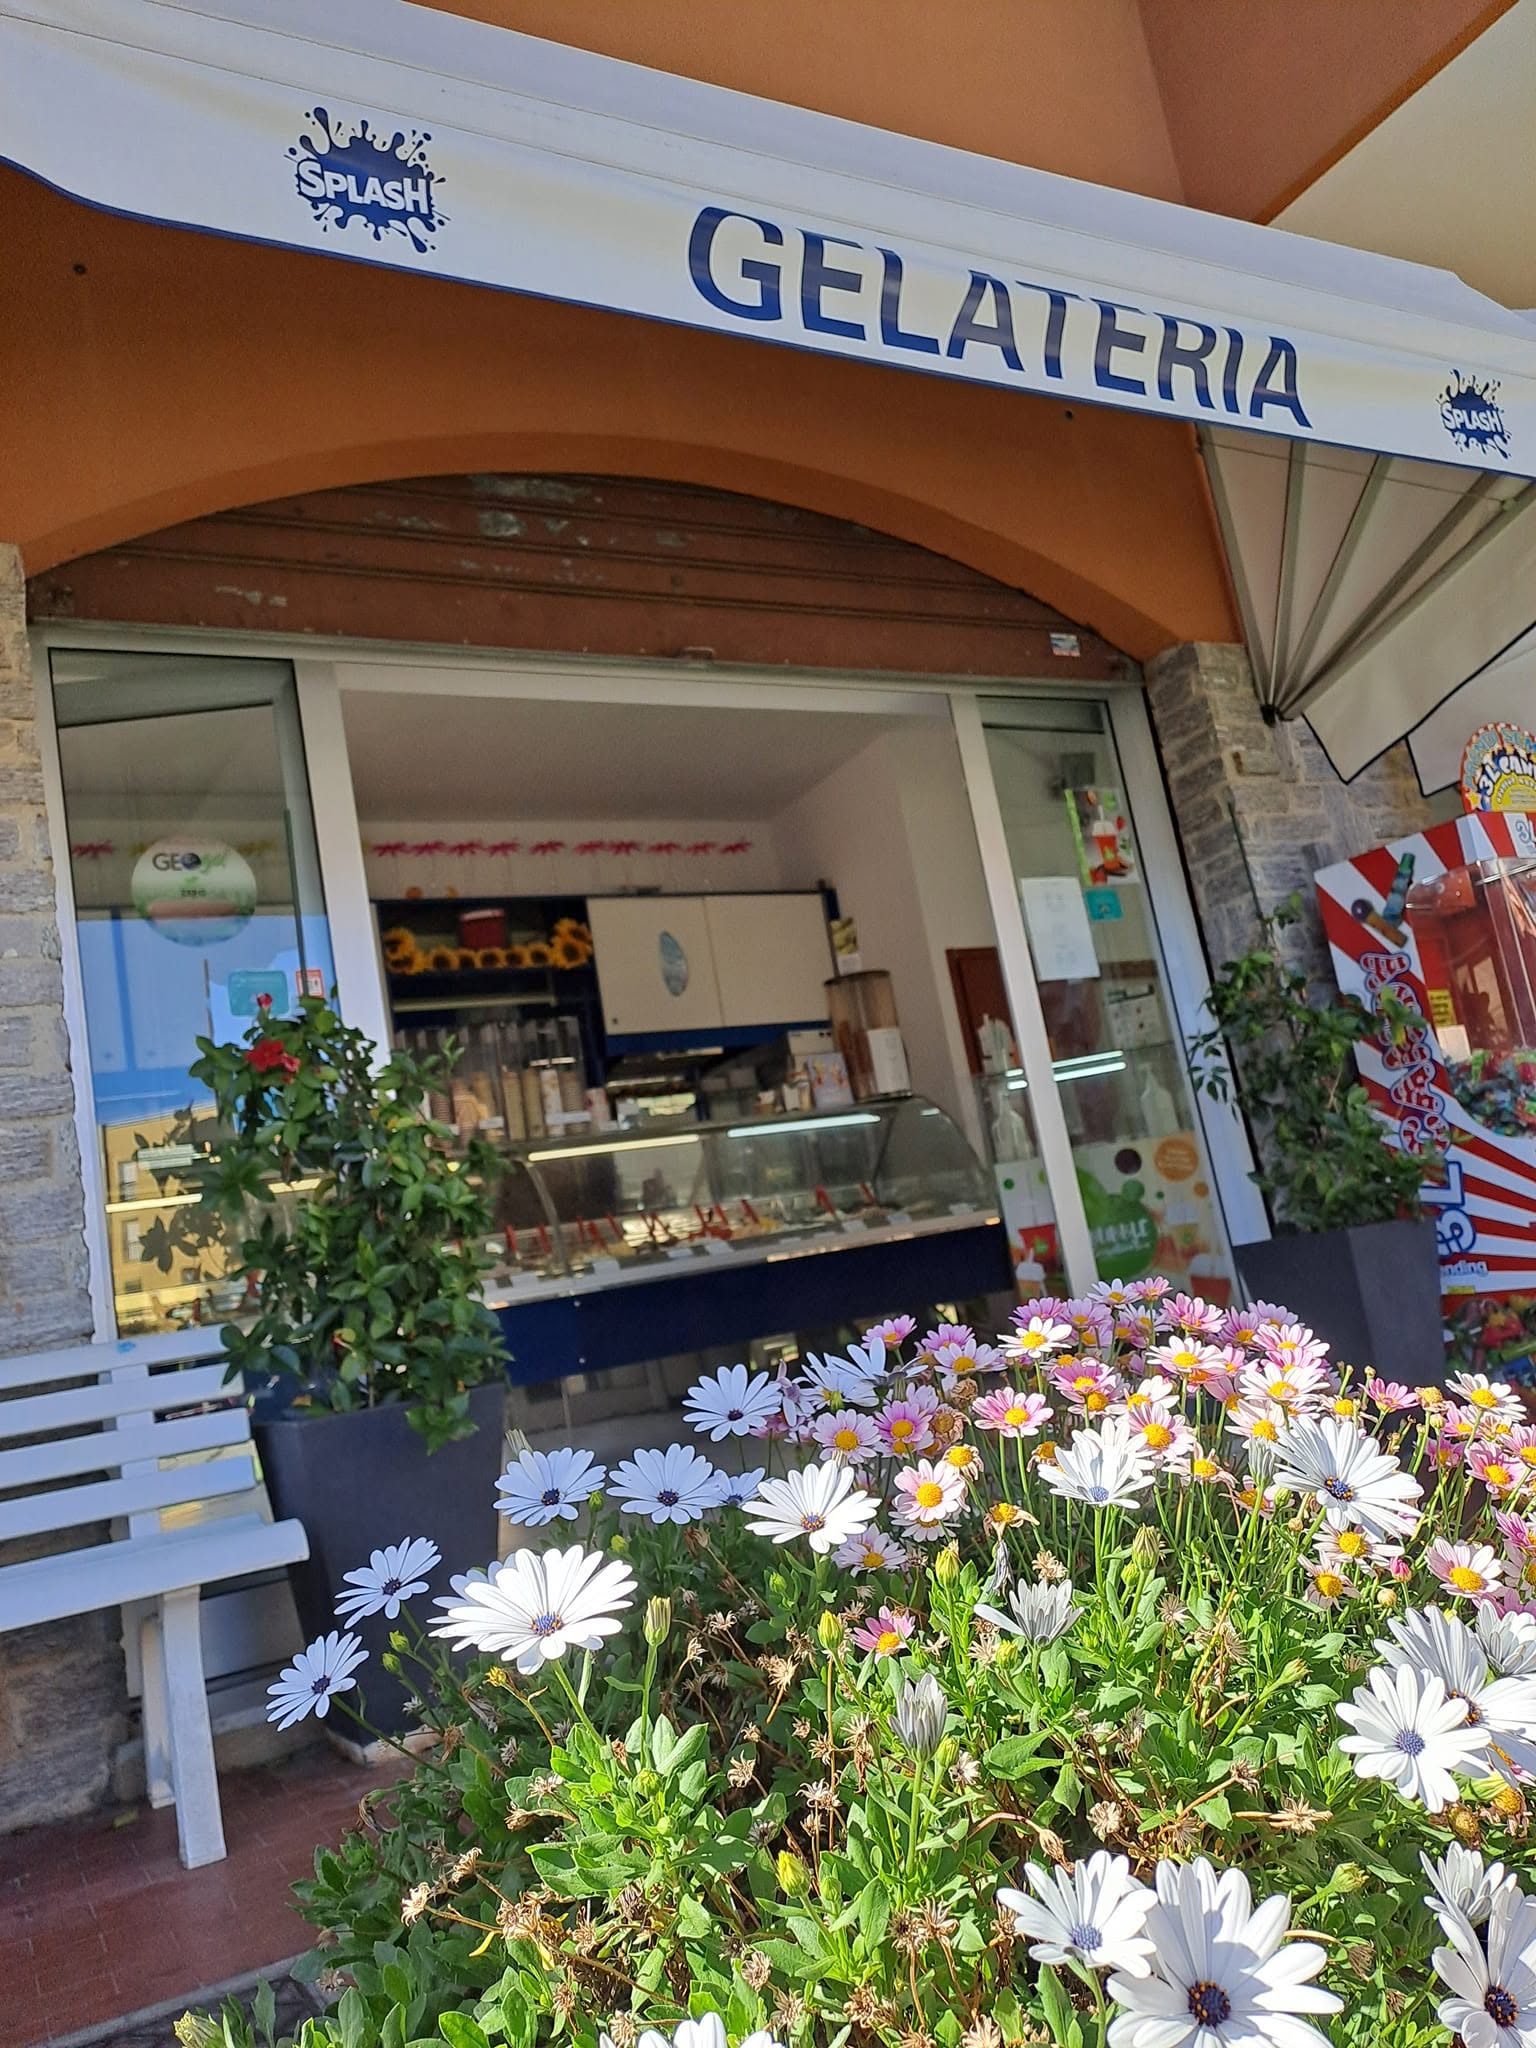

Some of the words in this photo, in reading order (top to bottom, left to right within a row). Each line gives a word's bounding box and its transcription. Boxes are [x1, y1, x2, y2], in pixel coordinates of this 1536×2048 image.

[299, 159, 430, 214] SPLASH
[689, 206, 1313, 428] GELATERIA
[1441, 401, 1503, 433] SPLASH
[1499, 755, 1536, 781] CAN
